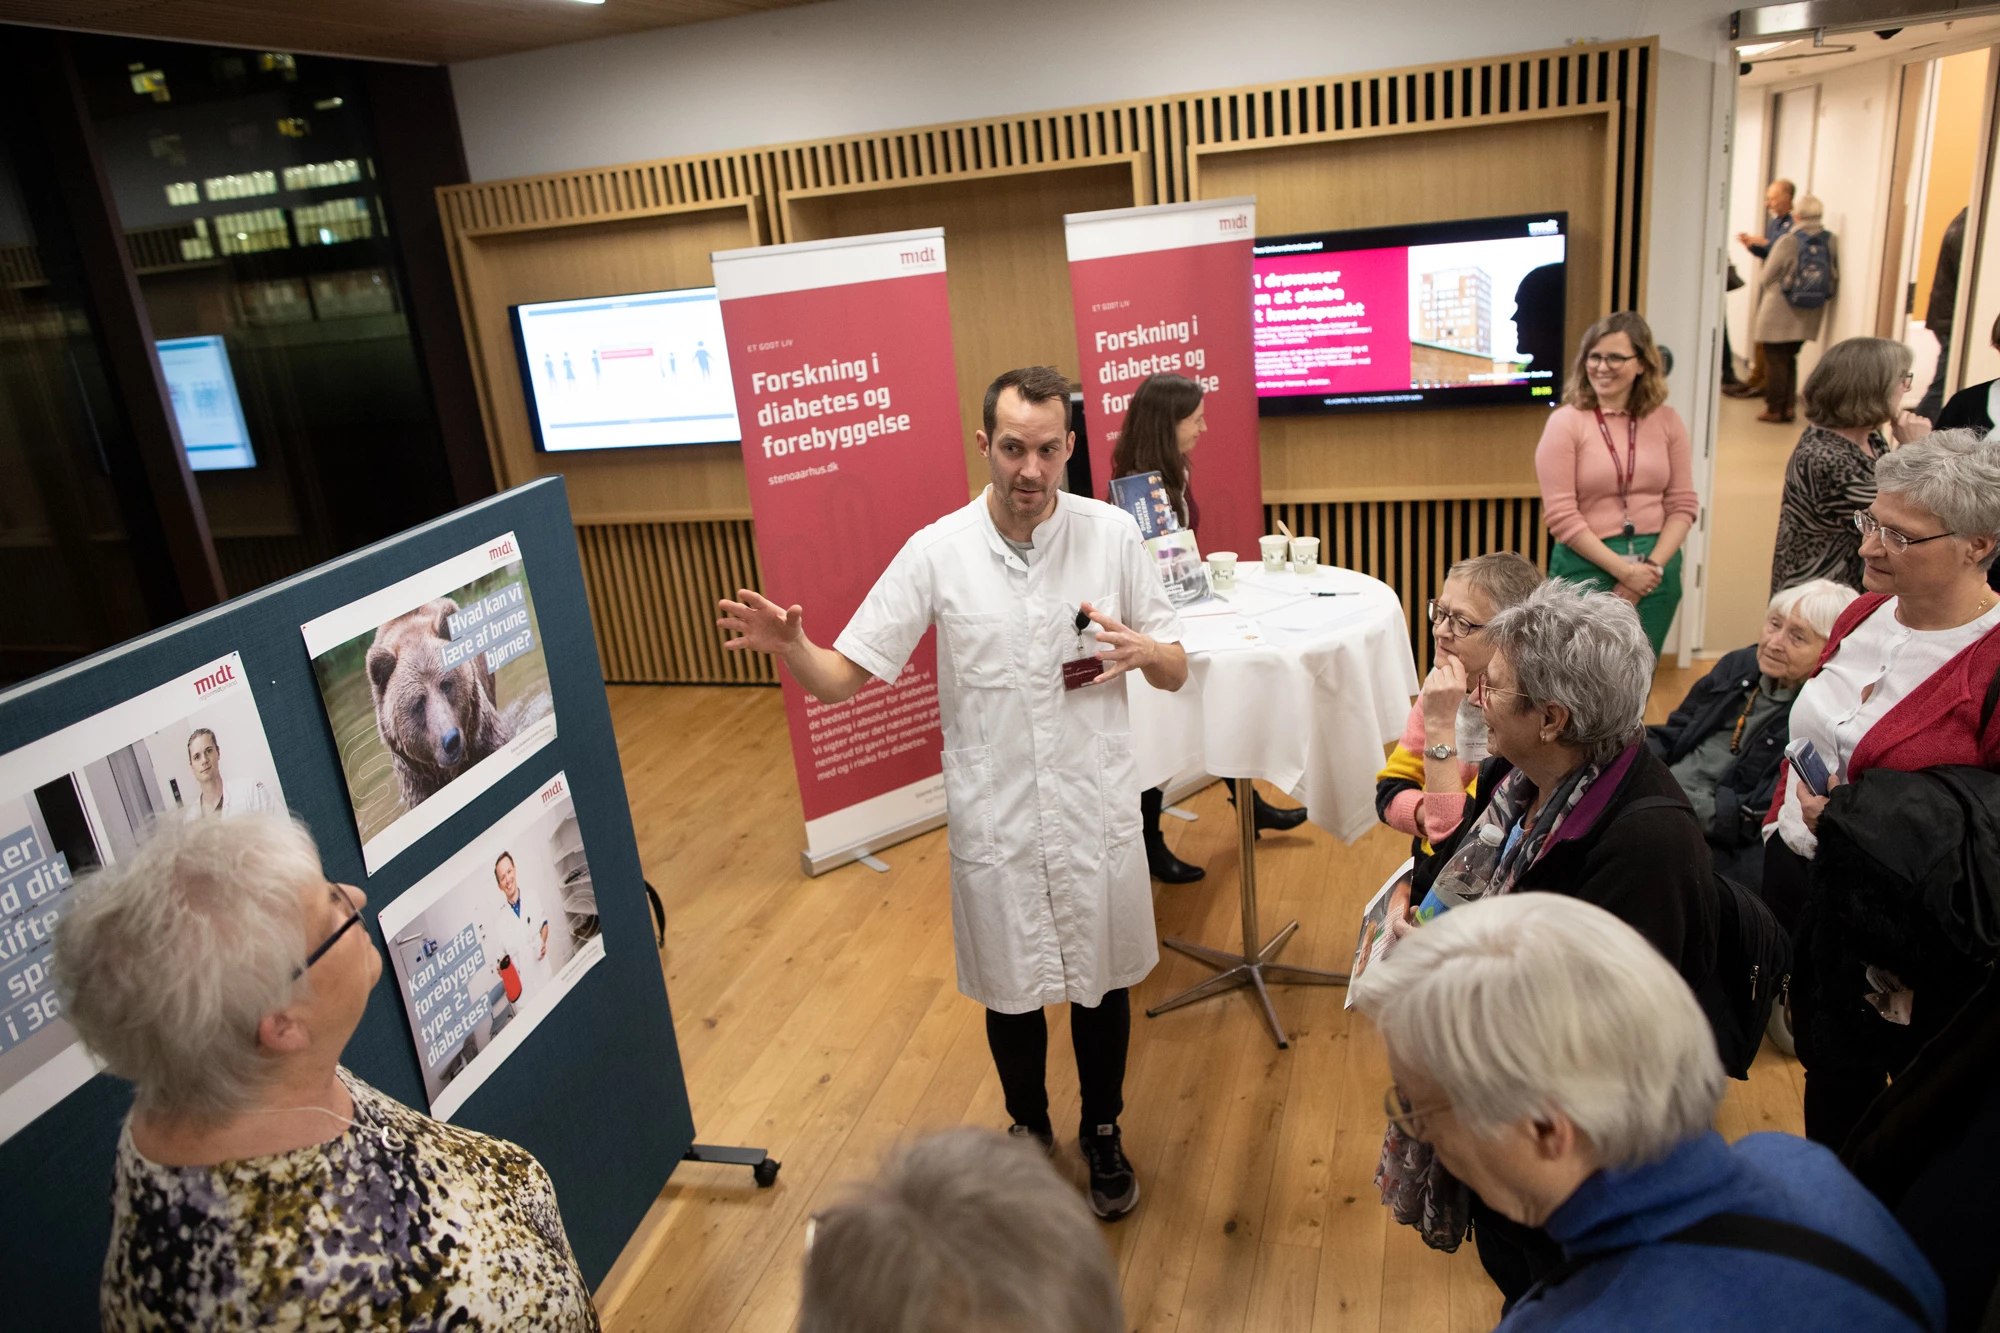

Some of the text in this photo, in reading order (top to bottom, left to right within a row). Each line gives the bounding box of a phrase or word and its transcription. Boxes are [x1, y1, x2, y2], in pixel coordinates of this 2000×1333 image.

[1219, 214, 1248, 231] midt
[900, 246, 936, 264] midt
[1265, 301, 1365, 322] knudepunkt
[1273, 289, 1293, 305] at
[1294, 286, 1345, 303] skabe
[747, 339, 794, 353] ET GODT LIV
[1095, 314, 1198, 353] Forskning i
[752, 352, 880, 395] Forskning i
[1099, 348, 1205, 384] diabetes og
[757, 386, 891, 427] diabetes og
[762, 413, 911, 459] forebyggelse
[768, 461, 839, 486] stenoaarhus.dk
[488, 540, 514, 560] midt
[448, 582, 523, 635] Hvad kan vi
[441, 610, 528, 667] lære af brune
[484, 629, 531, 670] bjørne?
[194, 663, 235, 695] midt
[894, 674, 921, 689] skaber
[922, 670, 930, 680] vi
[903, 663, 914, 674] og
[809, 720, 820, 730] de
[821, 710, 851, 726] bedste
[852, 700, 884, 715] rammer
[886, 694, 899, 704] for
[811, 723, 852, 743] forskning
[852, 720, 856, 729] i
[857, 711, 888, 727] absolut
[813, 745, 822, 755] Vi
[823, 738, 848, 752] sigter
[849, 730, 871, 744] efter
[871, 724, 886, 736] det
[886, 716, 913, 731] næste
[913, 711, 928, 722] nye
[815, 747, 855, 768] nembrud
[855, 744, 864, 755] til
[864, 738, 885, 753] gavn
[886, 733, 898, 744] for
[817, 737, 928, 781] med og i risiko for diabetes.
[541, 780, 563, 804] midt
[26, 860, 69, 900] dit
[408, 928, 474, 997] Kan kaffe
[414, 949, 484, 1021] forebygge
[5, 1015, 20, 1042] i
[421, 992, 469, 1044] type 2-
[427, 994, 490, 1068] diabetes?
